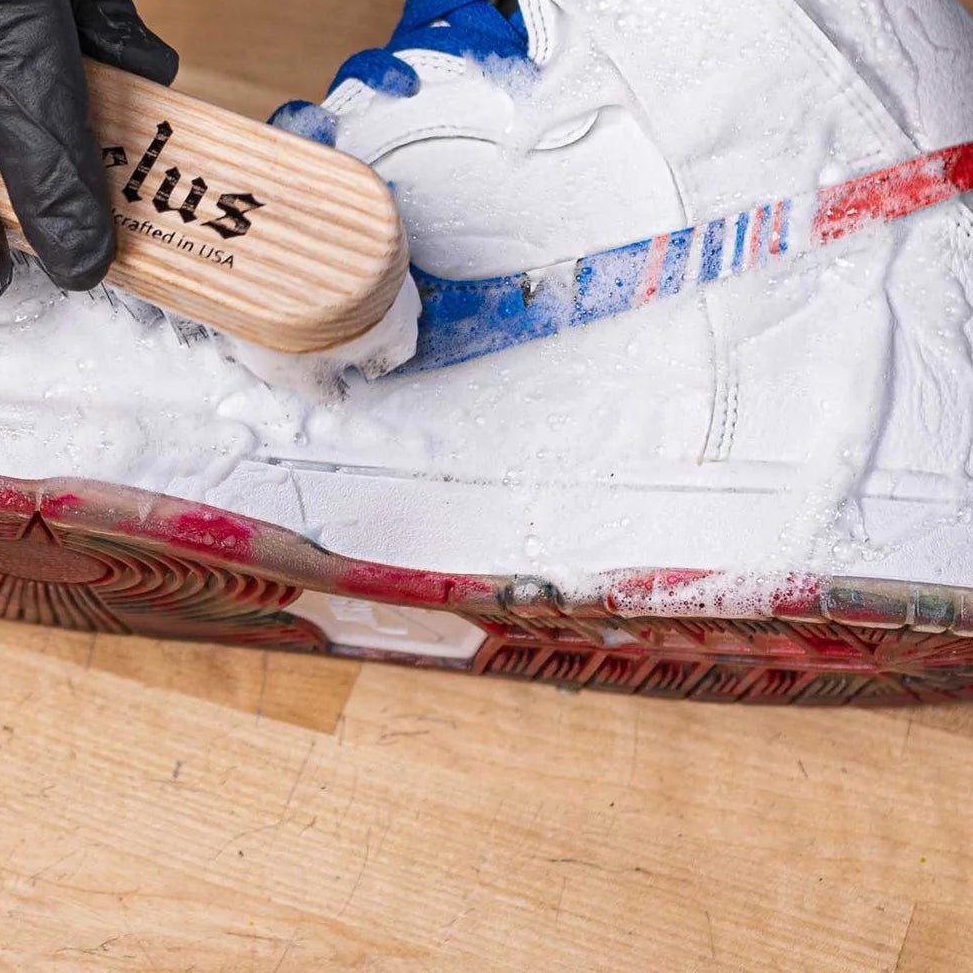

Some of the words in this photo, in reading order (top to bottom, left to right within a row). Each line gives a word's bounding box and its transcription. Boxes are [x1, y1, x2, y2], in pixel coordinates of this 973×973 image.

[111, 207, 176, 244] crafted
[178, 235, 196, 252] in
[198, 244, 234, 269] USA
